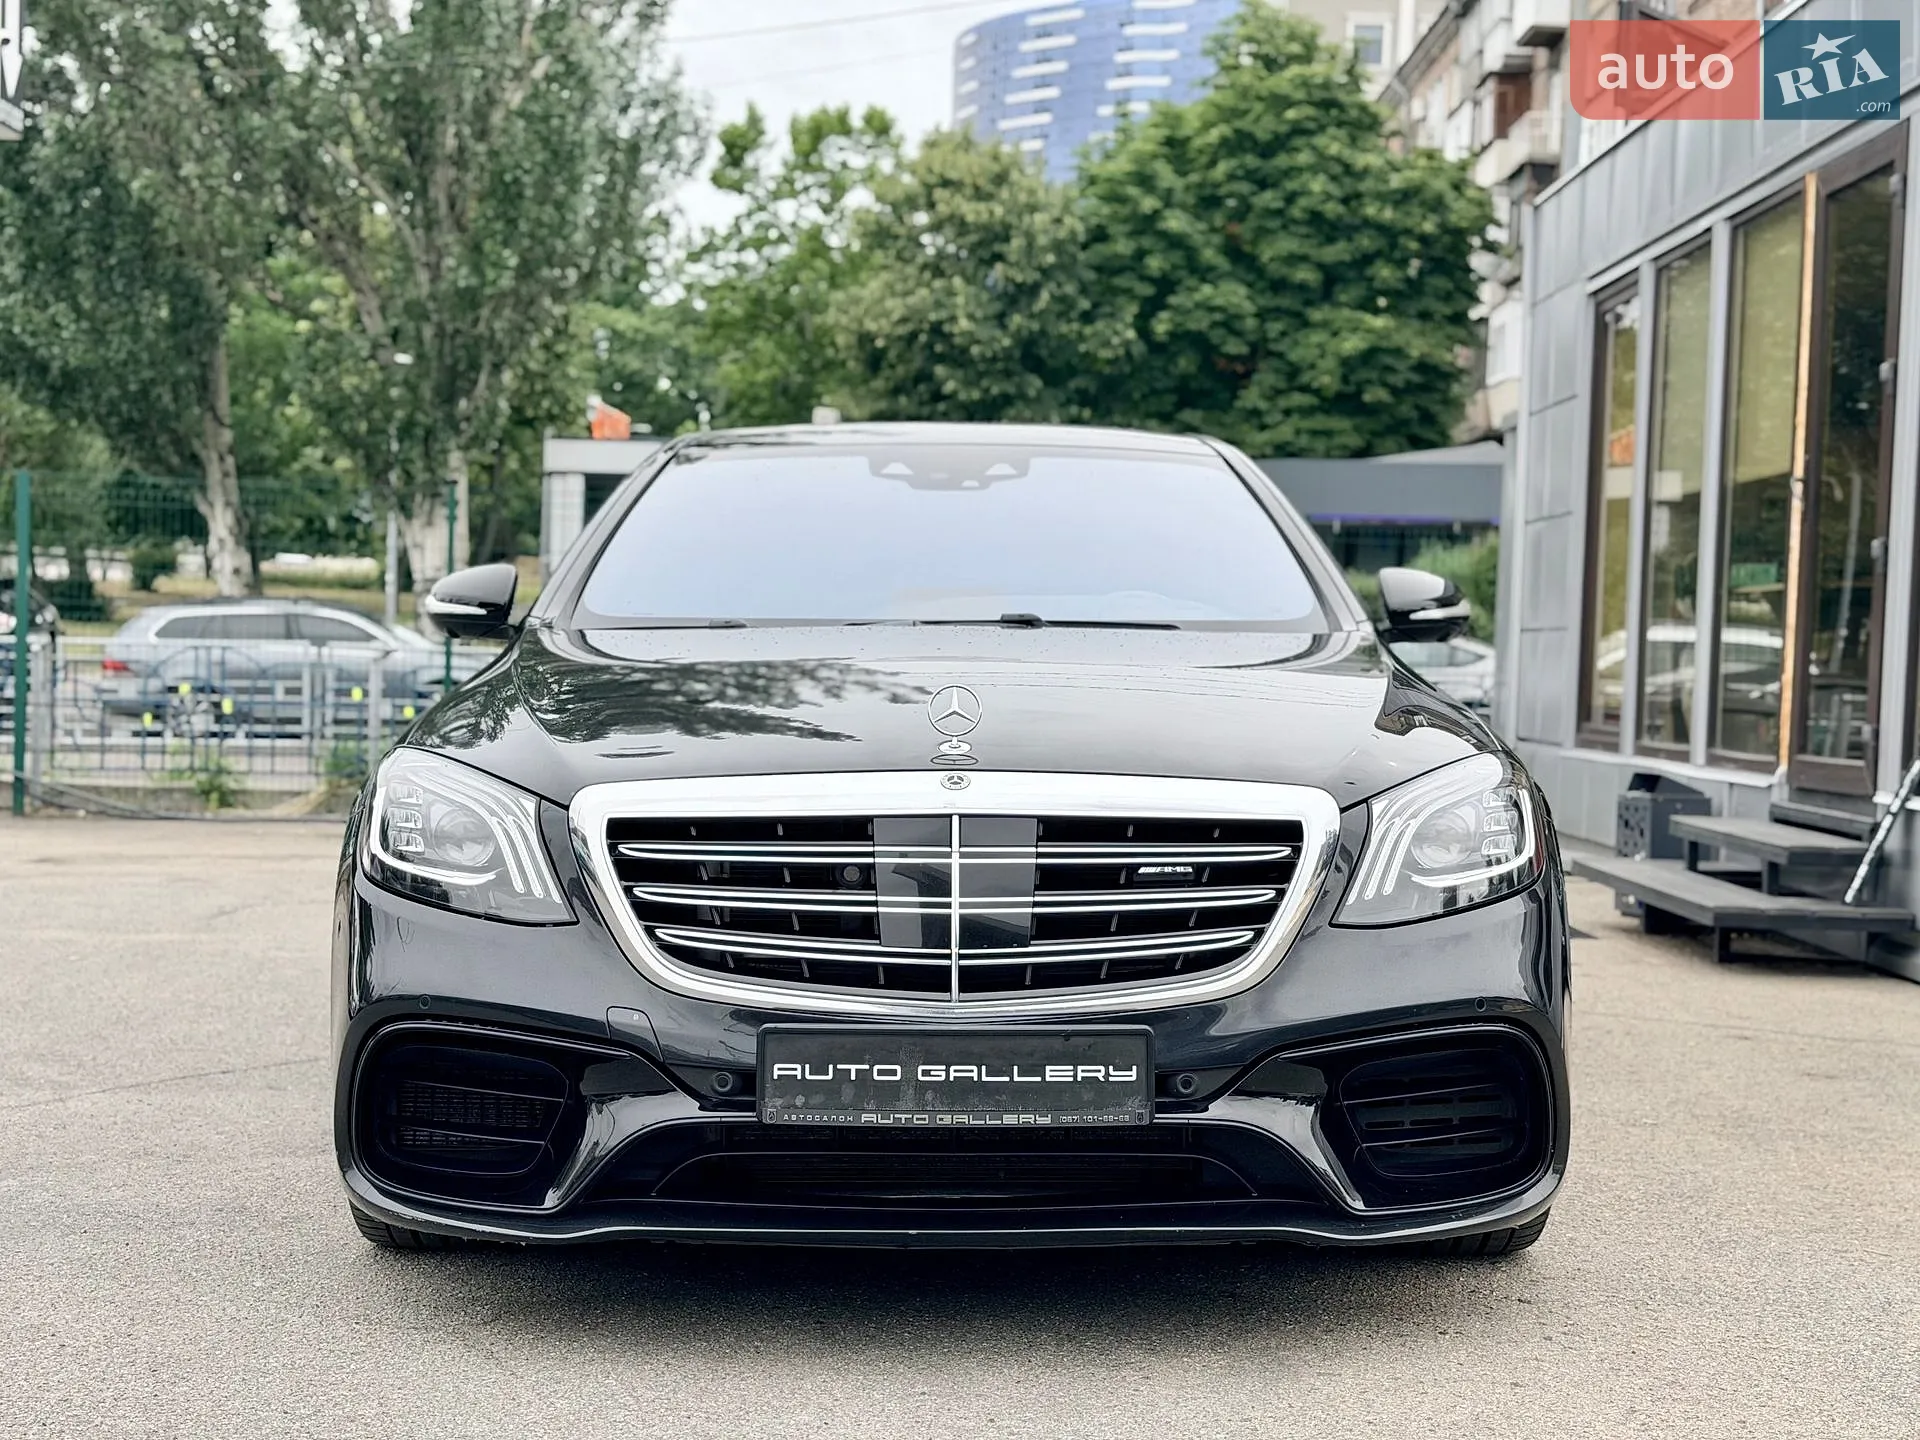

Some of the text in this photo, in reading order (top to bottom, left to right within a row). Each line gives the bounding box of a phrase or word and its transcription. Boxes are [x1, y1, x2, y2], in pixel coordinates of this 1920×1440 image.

[773, 1063, 1138, 1082] AUTO GALLERY
[861, 1113, 929, 1124] AUTO
[936, 1114, 1051, 1125] GALLERY
